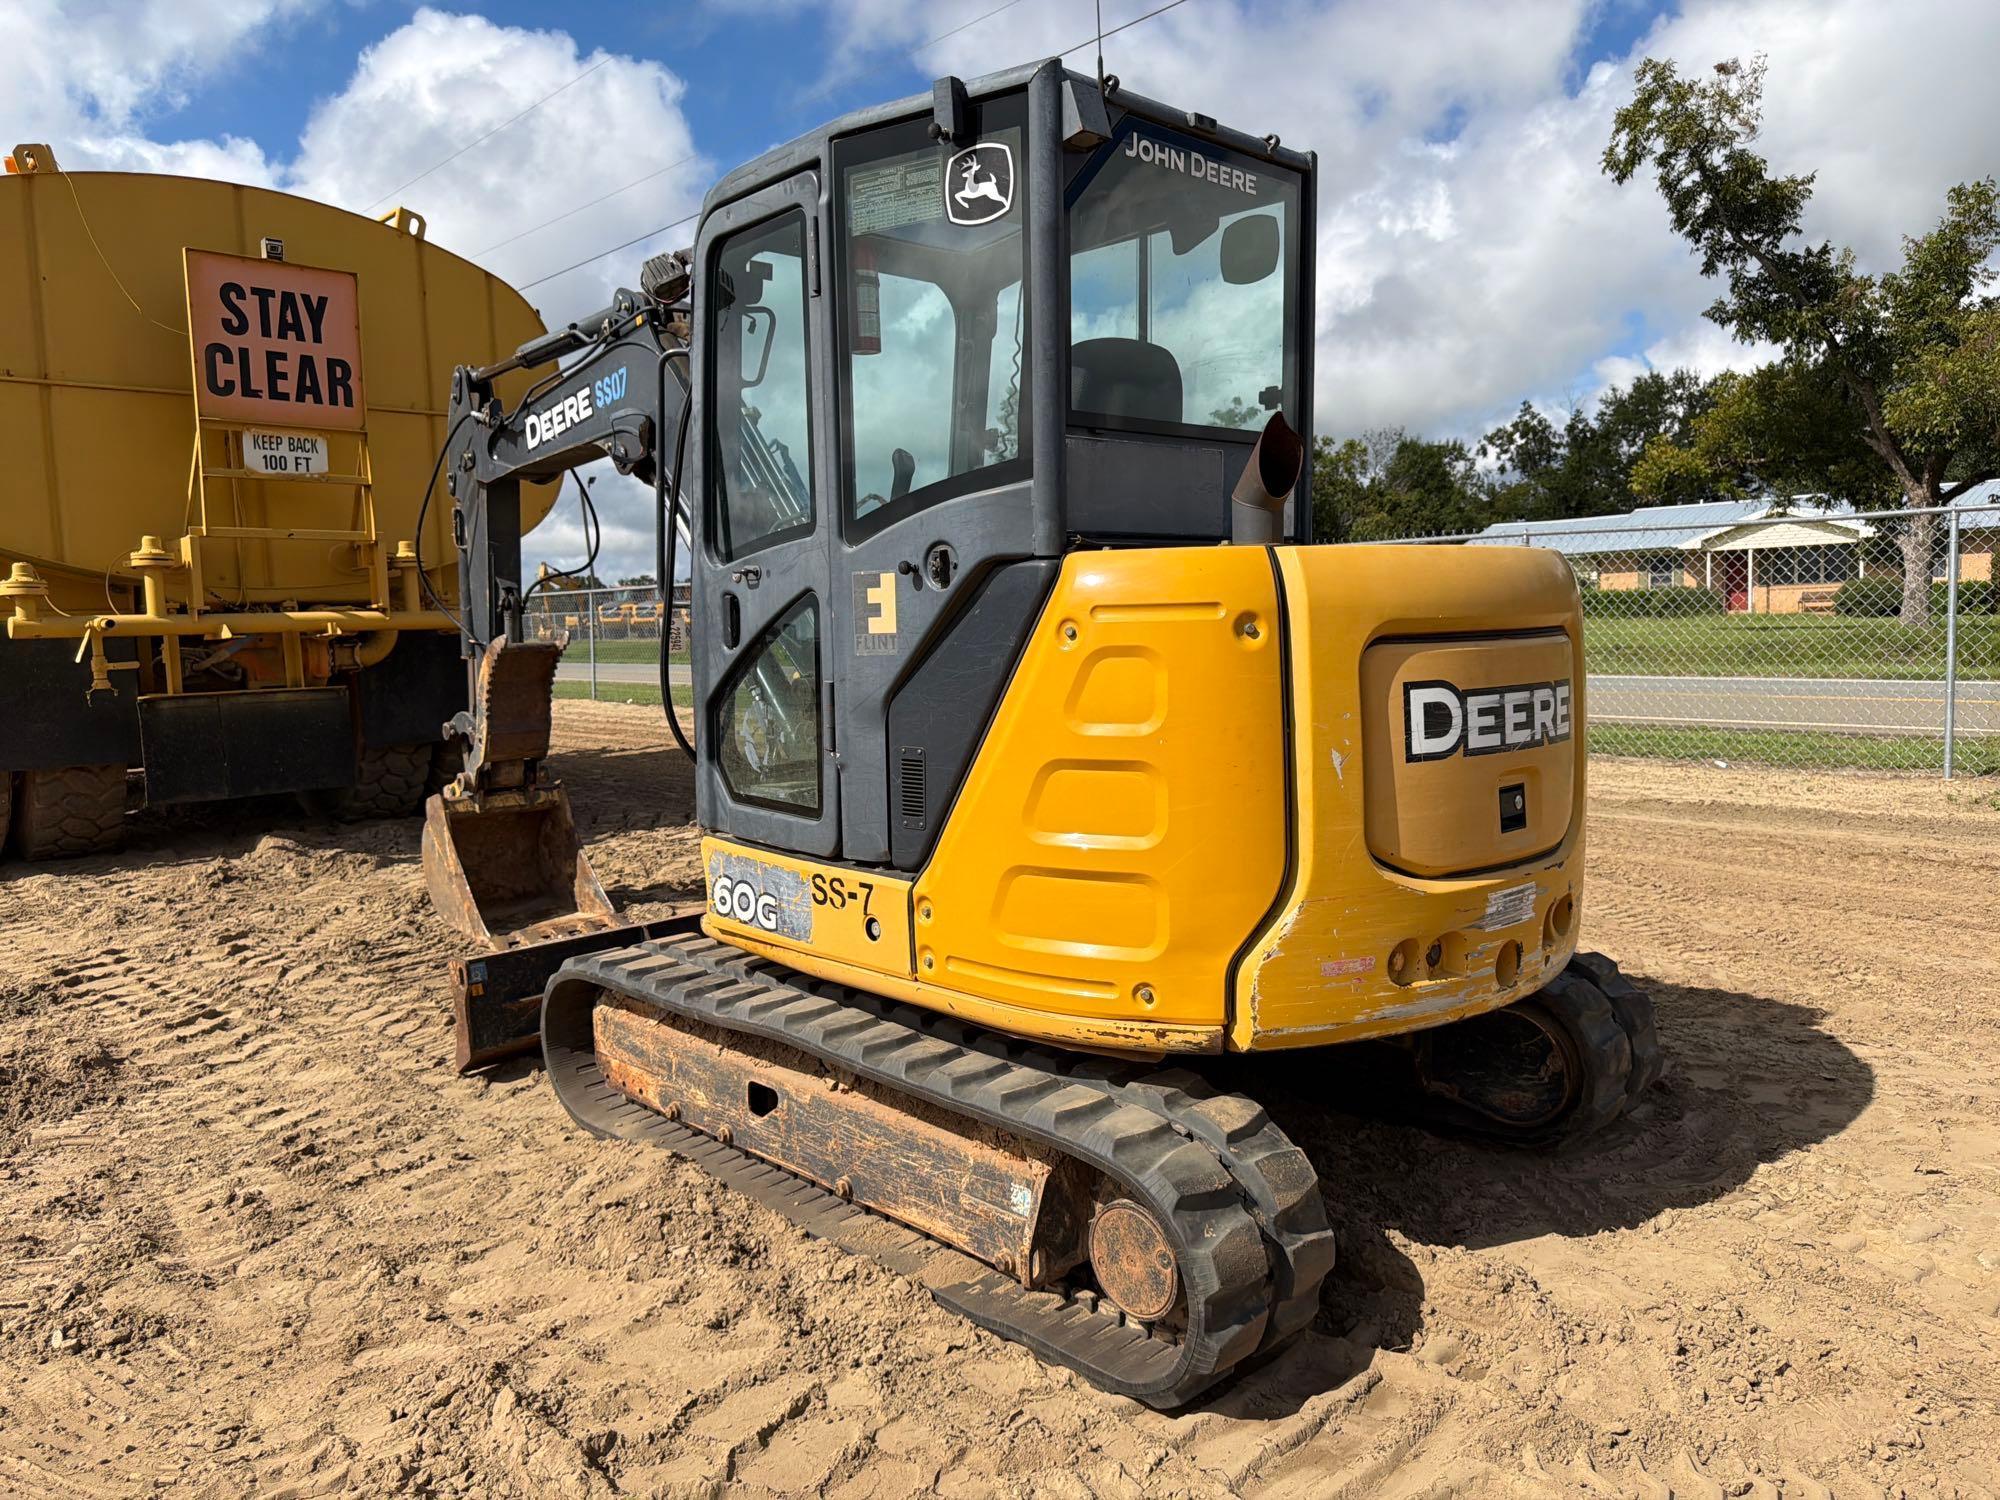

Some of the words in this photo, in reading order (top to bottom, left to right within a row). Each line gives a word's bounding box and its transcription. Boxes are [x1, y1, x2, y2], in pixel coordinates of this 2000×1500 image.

[1125, 131, 1185, 173] JOHN
[1190, 151, 1257, 195] DEERE
[219, 282, 328, 344] STAY
[204, 343, 354, 407] CLEAR
[524, 386, 593, 450] DEERE
[594, 366, 627, 409] SS07
[252, 434, 283, 452] KEEP
[288, 437, 319, 454] BACK
[262, 454, 288, 471] 100
[295, 457, 312, 472] FT
[856, 635, 897, 650] FLINT
[1406, 681, 1570, 759] DEERE
[712, 874, 778, 931] 60G
[811, 873, 874, 916] SS-7
